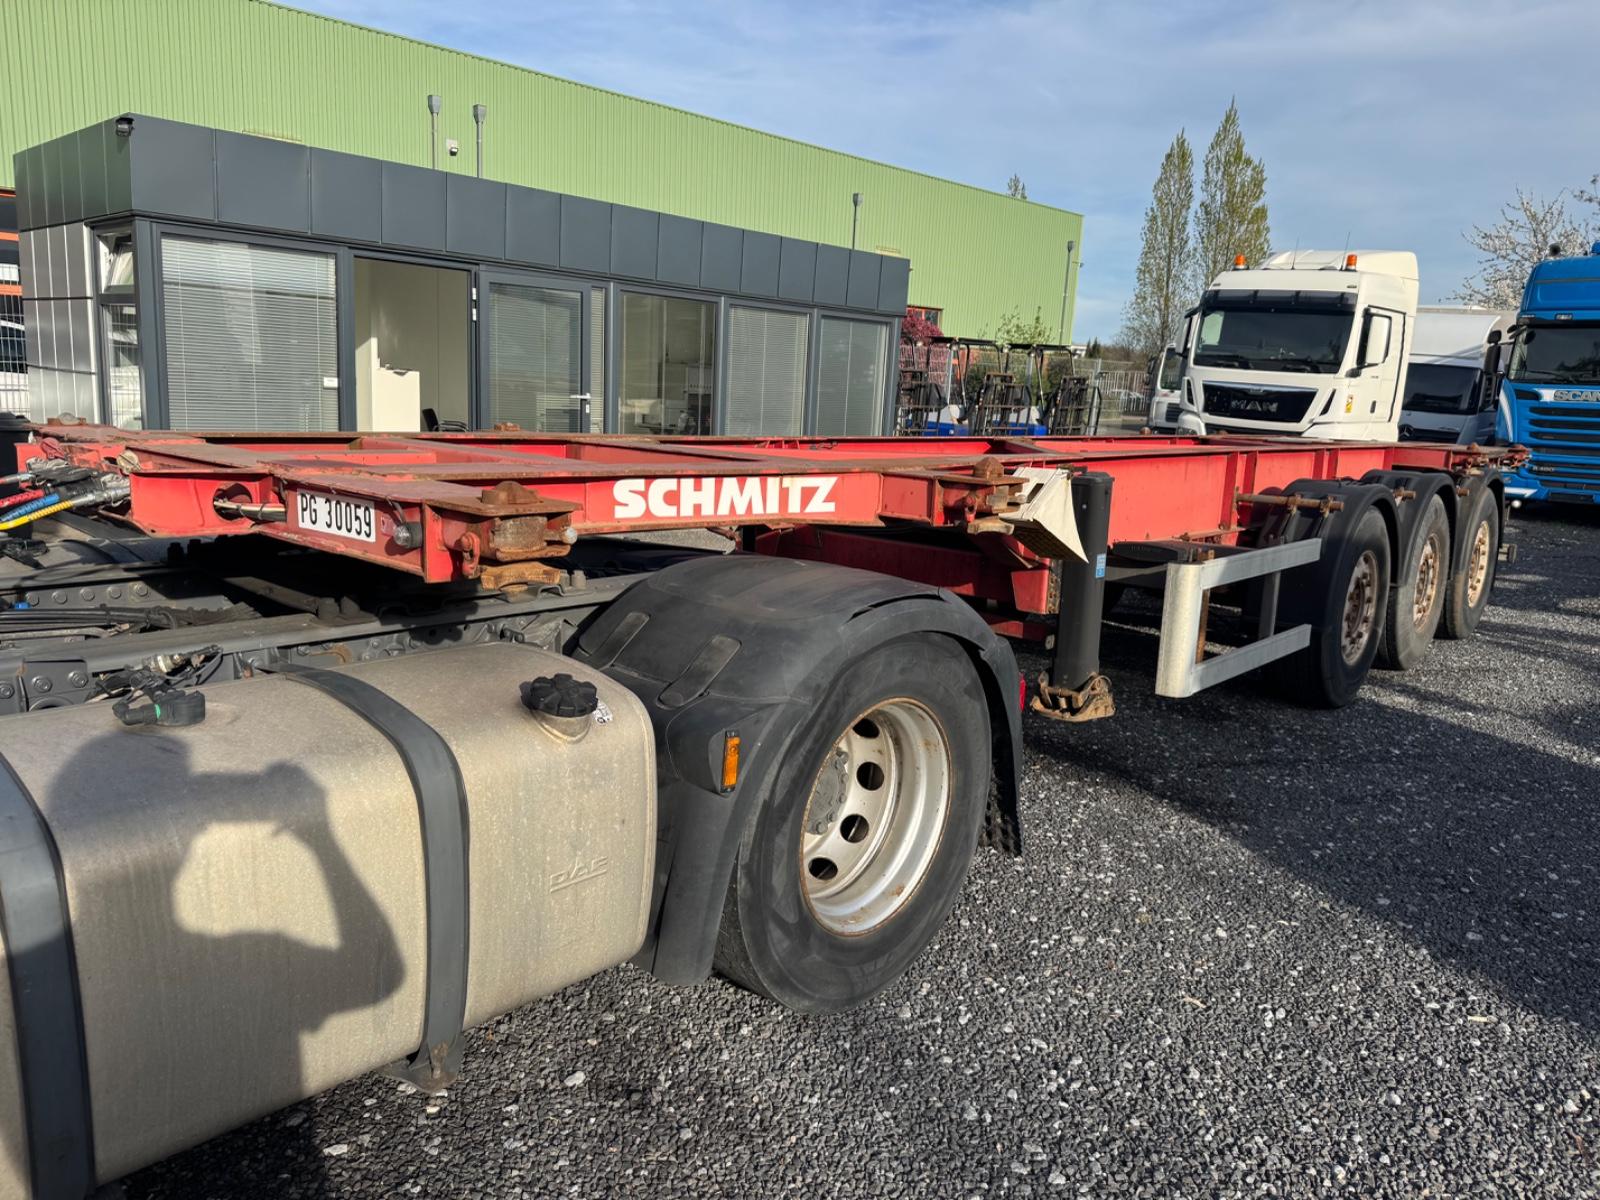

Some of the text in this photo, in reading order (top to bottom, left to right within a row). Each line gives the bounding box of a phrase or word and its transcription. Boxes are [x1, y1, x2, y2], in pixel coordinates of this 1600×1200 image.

[1231, 399, 1279, 413] MAN
[301, 492, 372, 539] PG 30059
[613, 476, 837, 518] SCHMITZ
